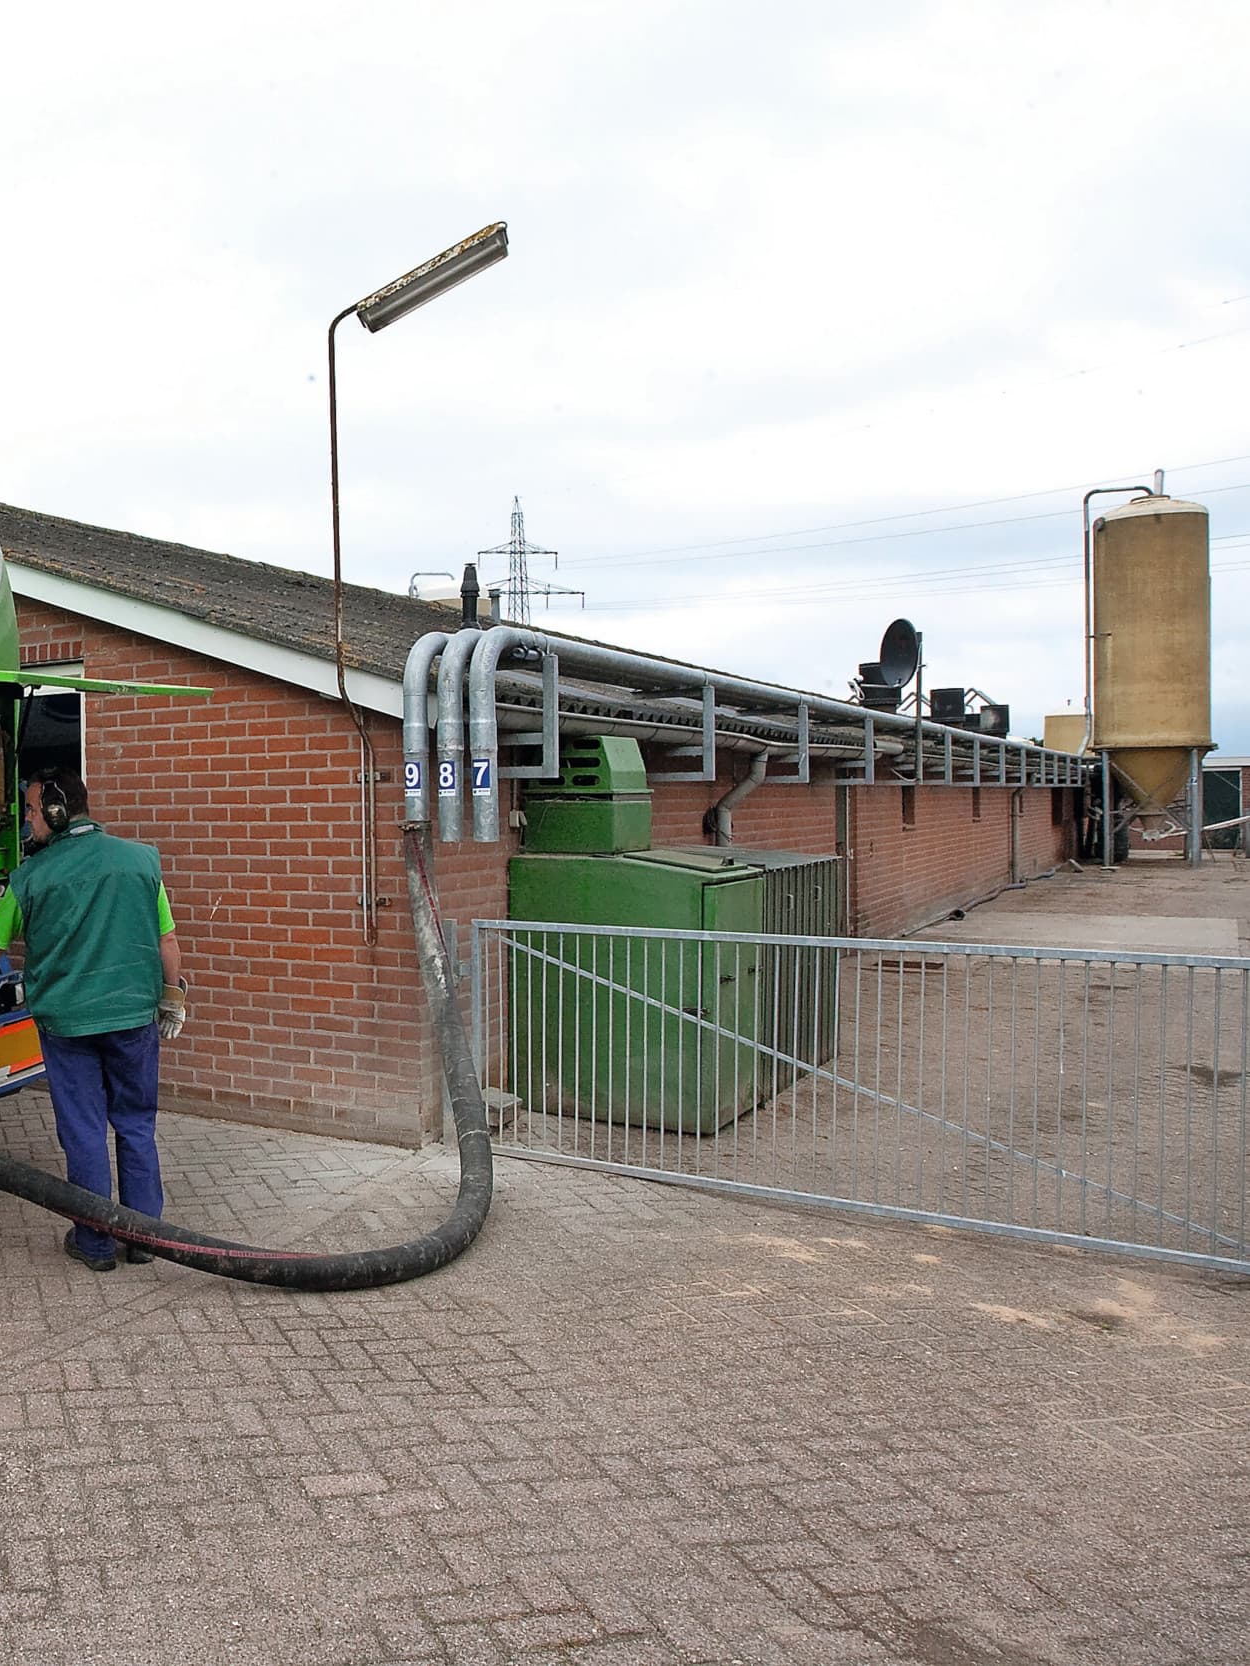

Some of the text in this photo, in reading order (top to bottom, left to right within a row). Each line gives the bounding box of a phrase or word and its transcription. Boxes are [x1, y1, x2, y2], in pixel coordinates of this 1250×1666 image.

[405, 763, 419, 788] 9
[439, 762, 454, 788] 8
[473, 761, 489, 786] 7
